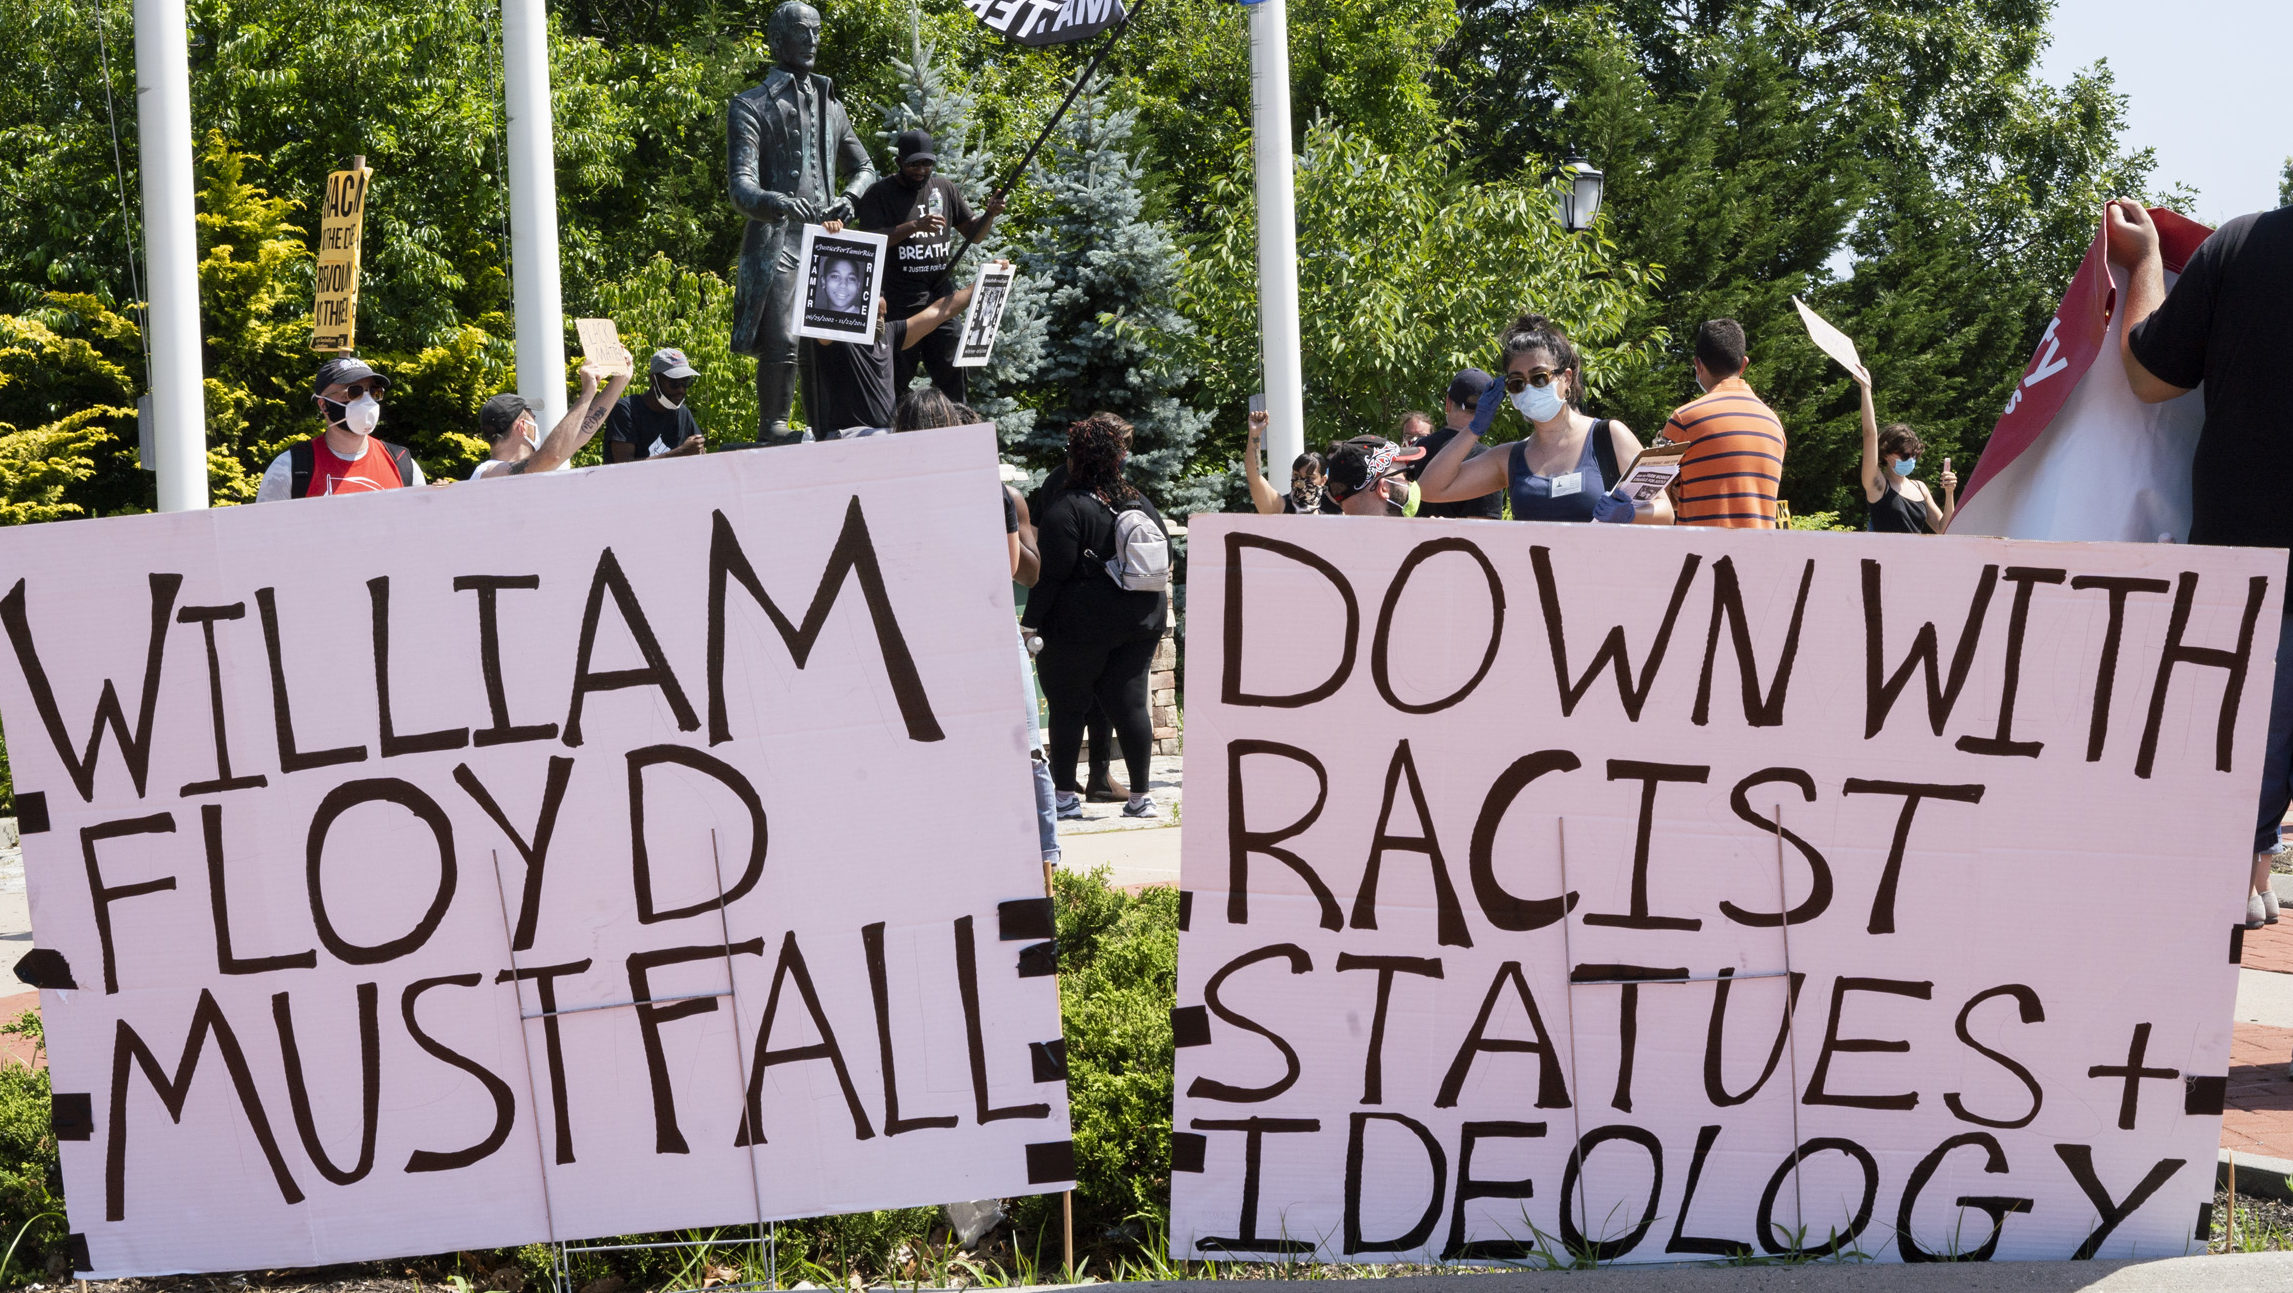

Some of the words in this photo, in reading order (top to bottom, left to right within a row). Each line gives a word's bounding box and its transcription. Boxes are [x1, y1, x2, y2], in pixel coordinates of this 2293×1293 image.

[806, 254, 819, 308] TAMIR
[861, 262, 873, 315] RICE
[908, 264, 930, 273] JUSTICE
[917, 204, 927, 218] I
[0, 496, 945, 802] WILLIAM
[1222, 532, 1814, 727] DOWN
[1862, 559, 2268, 778] WITH
[80, 745, 767, 994] FLOYD
[1228, 739, 1985, 948] RACIST
[106, 959, 592, 1221] MUST
[626, 916, 1050, 1155] FALL
[1187, 944, 2044, 1128] STATUES
[2088, 1023, 2179, 1129] +
[1191, 1113, 2186, 1264] IDEOLOGY
